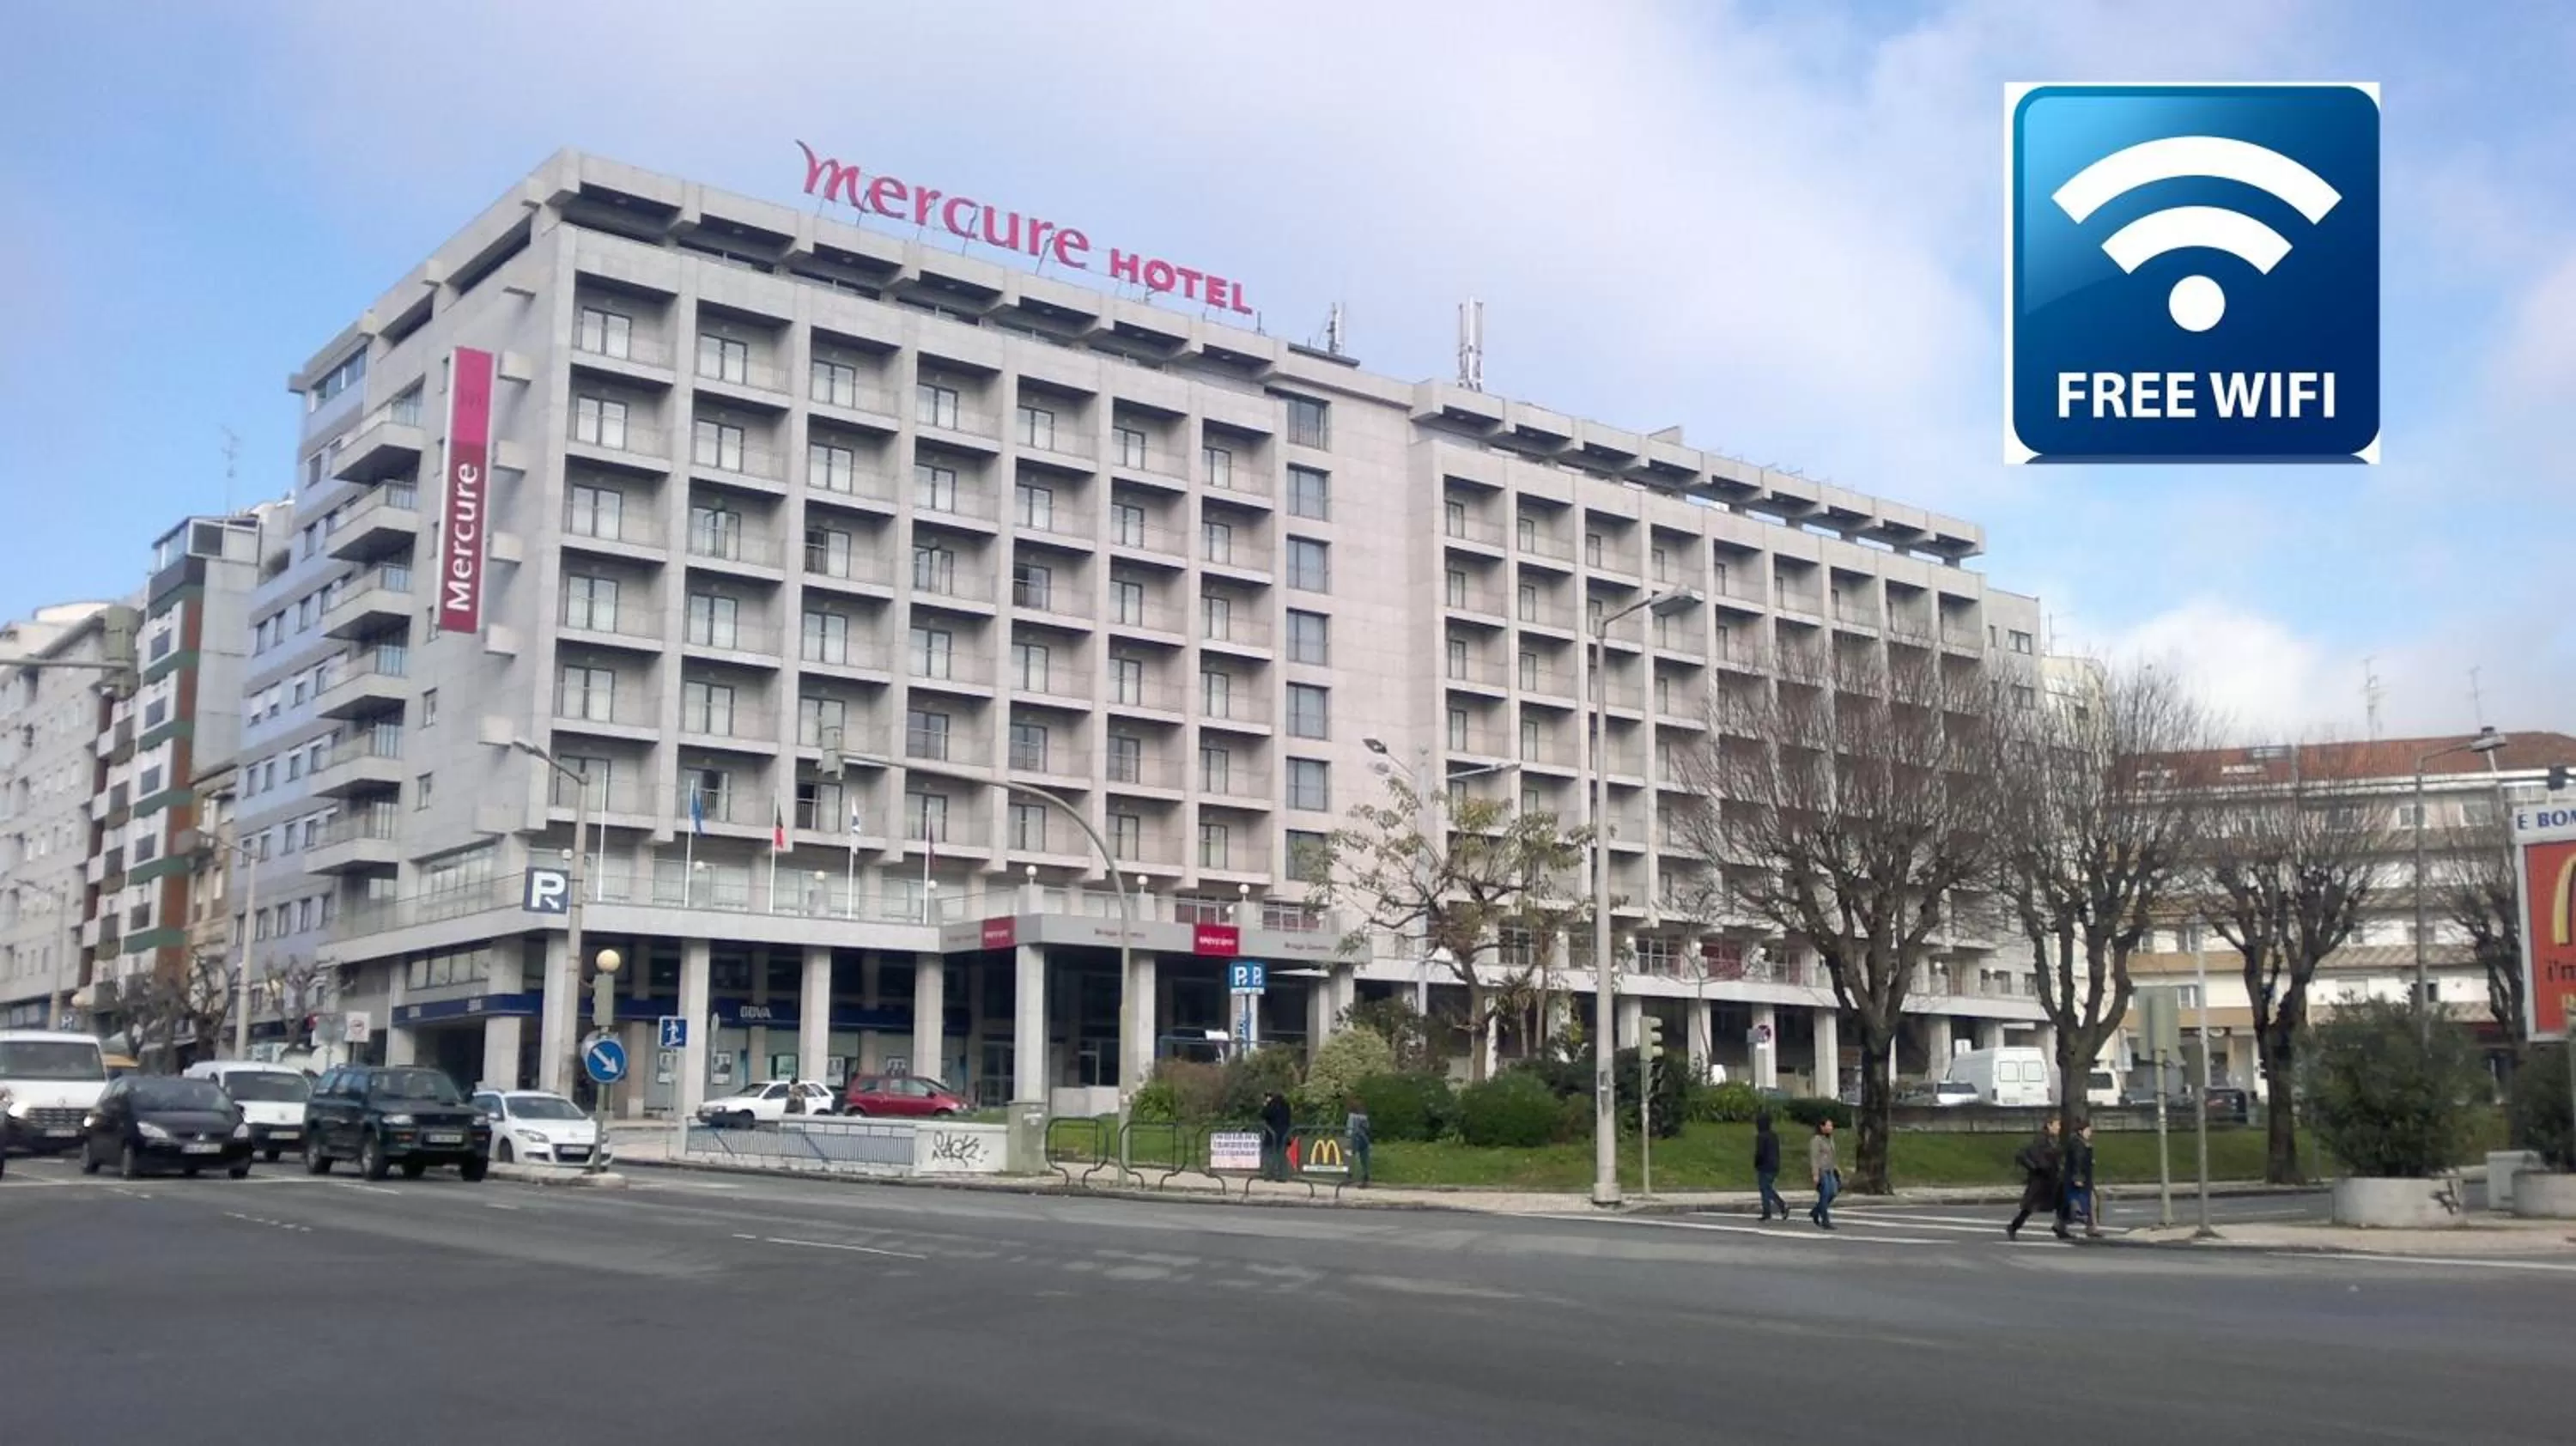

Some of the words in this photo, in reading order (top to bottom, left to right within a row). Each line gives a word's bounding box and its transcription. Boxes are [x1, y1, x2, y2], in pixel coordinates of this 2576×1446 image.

[1109, 247, 1253, 315] HOTEL
[446, 462, 478, 612] Mercure
[531, 872, 566, 908] P
